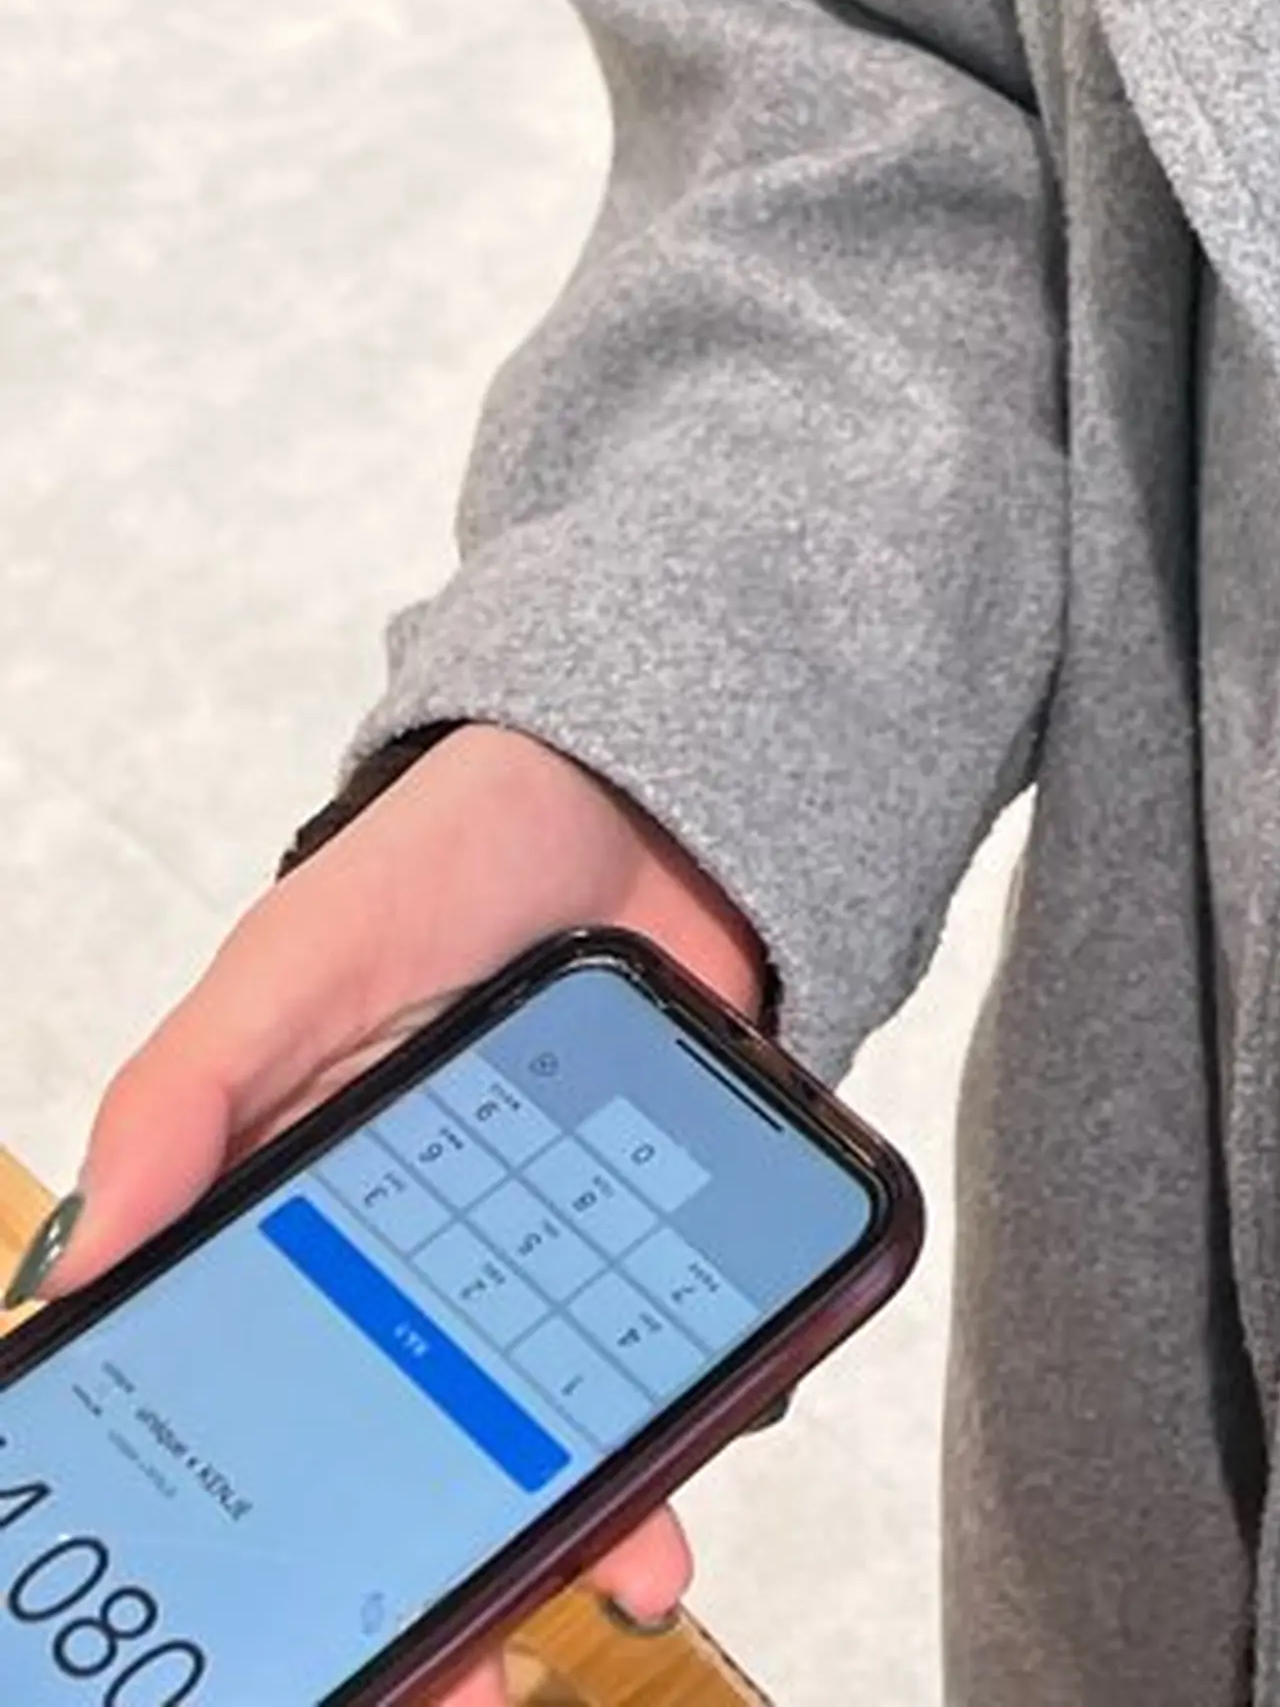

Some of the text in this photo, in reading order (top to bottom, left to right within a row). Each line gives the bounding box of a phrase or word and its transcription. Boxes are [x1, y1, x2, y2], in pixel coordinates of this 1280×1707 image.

[475, 1098, 499, 1124] 9
[419, 1139, 444, 1165] 6
[630, 1143, 656, 1166] 0
